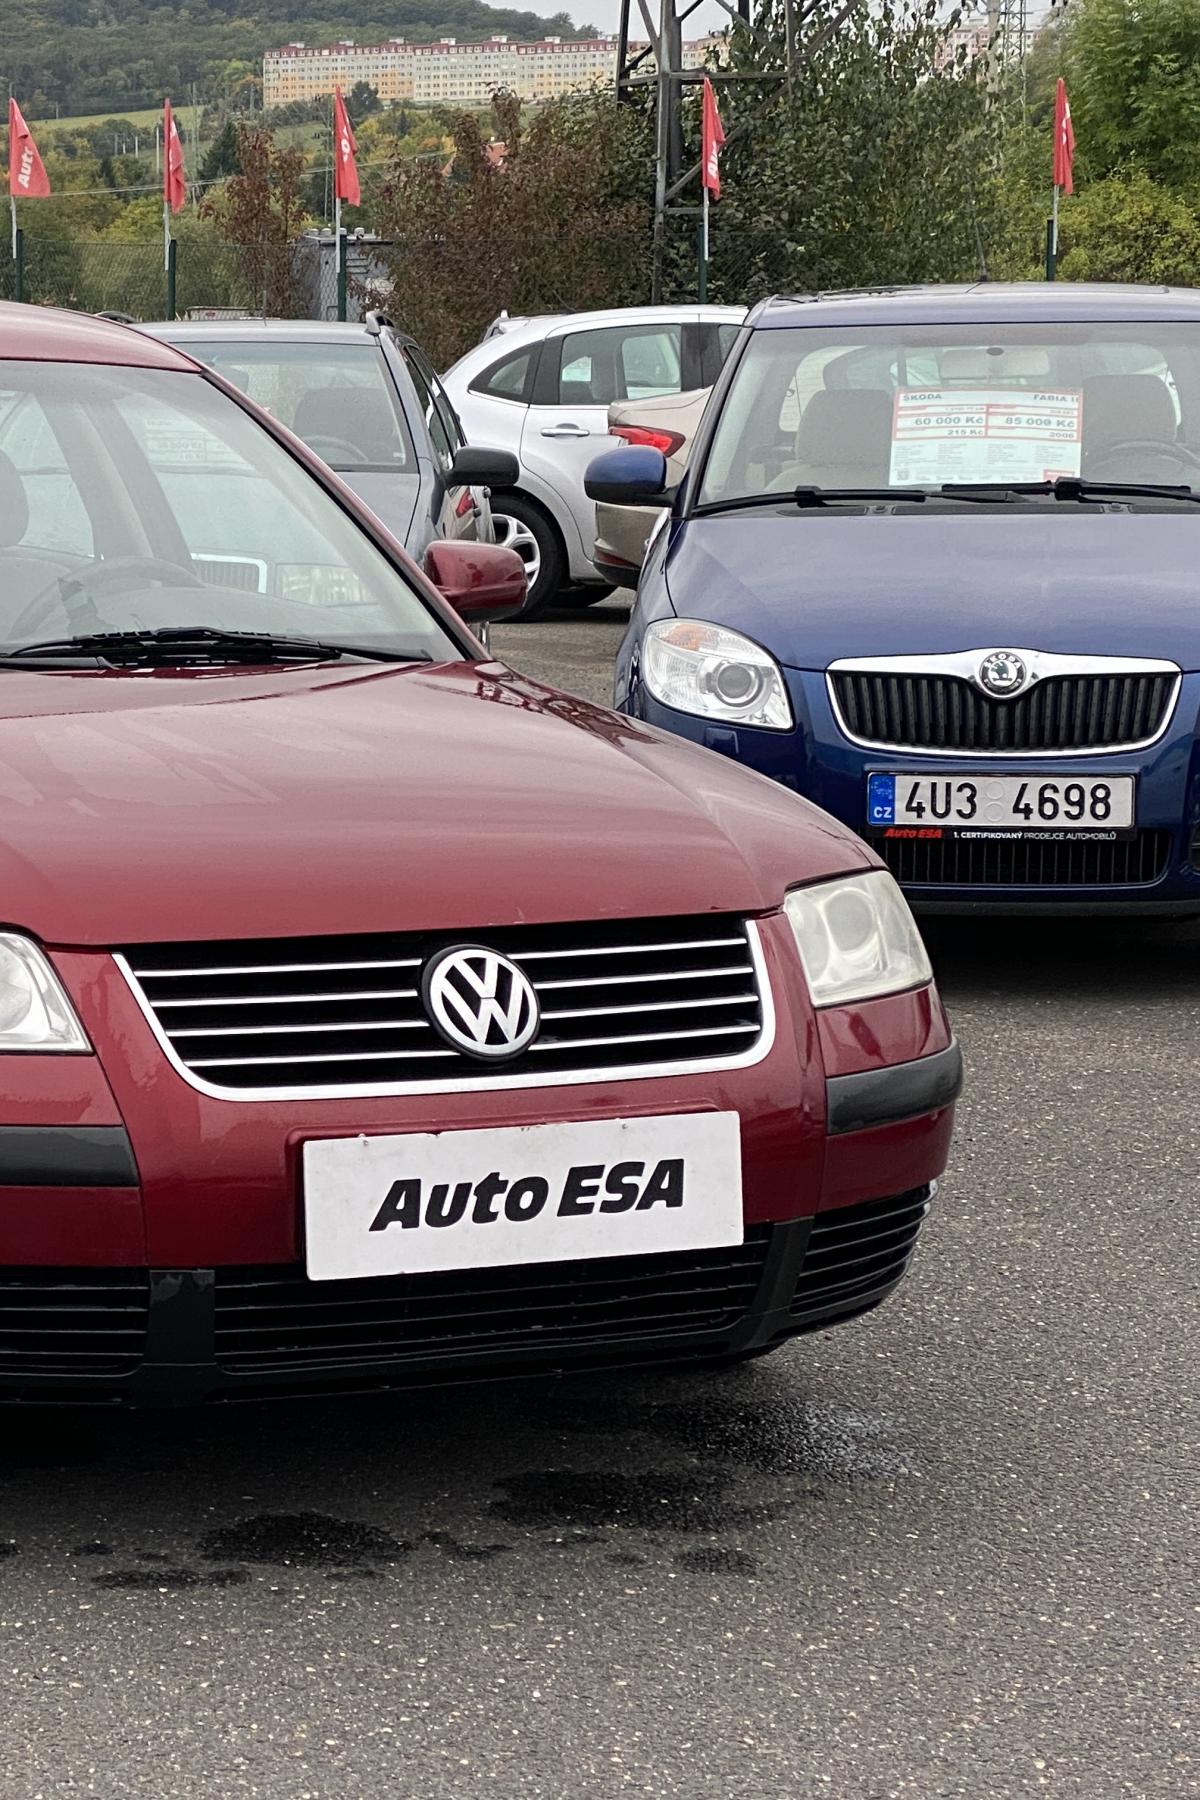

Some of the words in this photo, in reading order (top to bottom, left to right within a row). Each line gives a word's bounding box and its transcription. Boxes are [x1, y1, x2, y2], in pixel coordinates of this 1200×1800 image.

[1033, 394, 1067, 402] FABIA
[915, 418, 932, 426] 60
[935, 416, 961, 425] 000
[1005, 416, 1022, 425] 85
[905, 781, 978, 819] 4U3
[1012, 782, 1111, 820] 4698
[873, 807, 892, 818] CZ
[884, 828, 917, 838] Auto
[917, 828, 943, 838] ESA
[960, 830, 1022, 839] CERTIFIKOVANÝ
[1023, 832, 1065, 840] PRODEJCE
[1065, 831, 1117, 840] AUTOMOBILŮ
[368, 1171, 550, 1232] Auto
[556, 1158, 685, 1218] ESA
